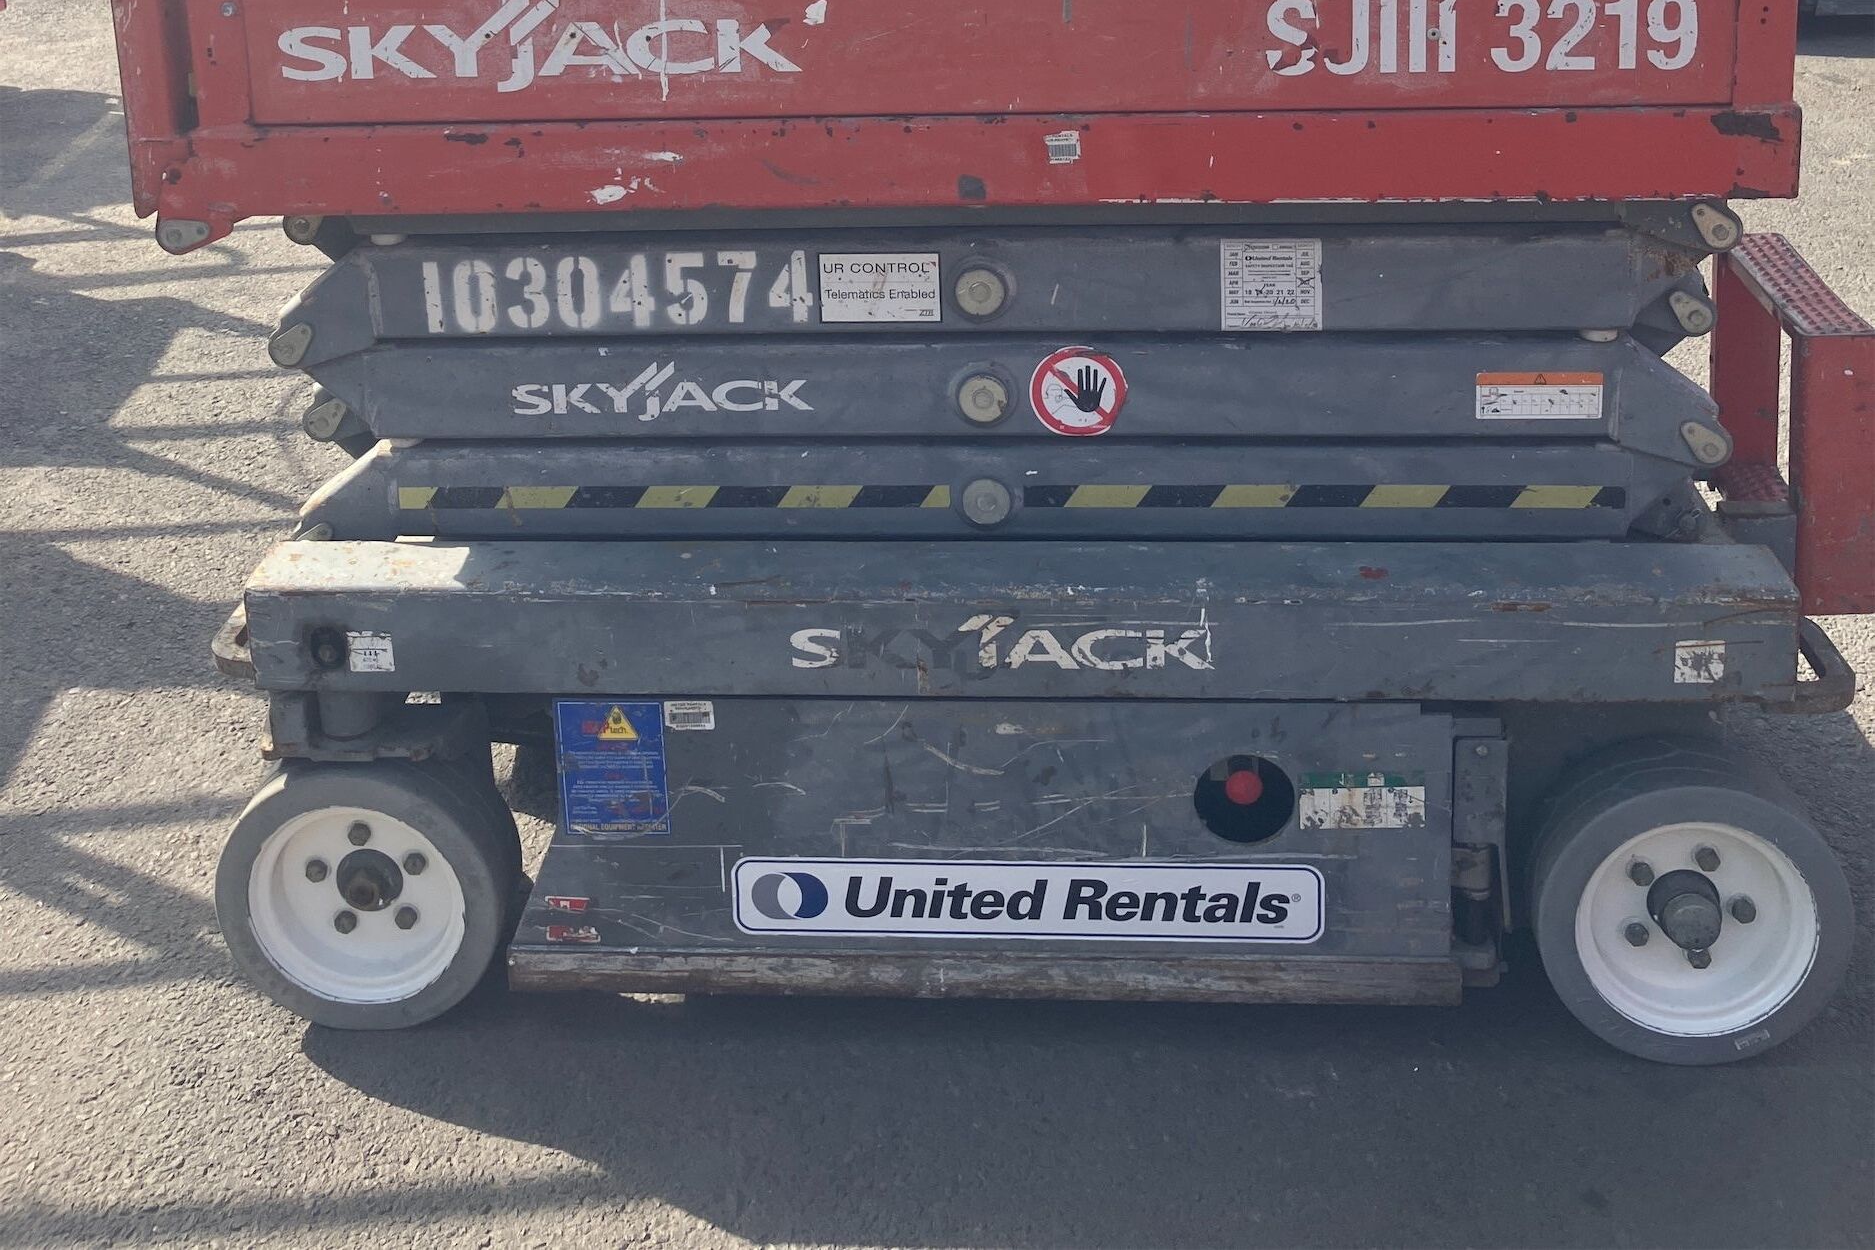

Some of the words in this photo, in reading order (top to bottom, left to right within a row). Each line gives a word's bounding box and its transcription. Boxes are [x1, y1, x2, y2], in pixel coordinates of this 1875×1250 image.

[422, 250, 814, 333] 10304574
[823, 263, 844, 273] UR
[850, 262, 930, 274] CONTROL
[825, 289, 885, 299] Telematics
[889, 289, 936, 300] Enabled
[512, 361, 815, 421] SKYJACK
[844, 875, 1047, 922] United
